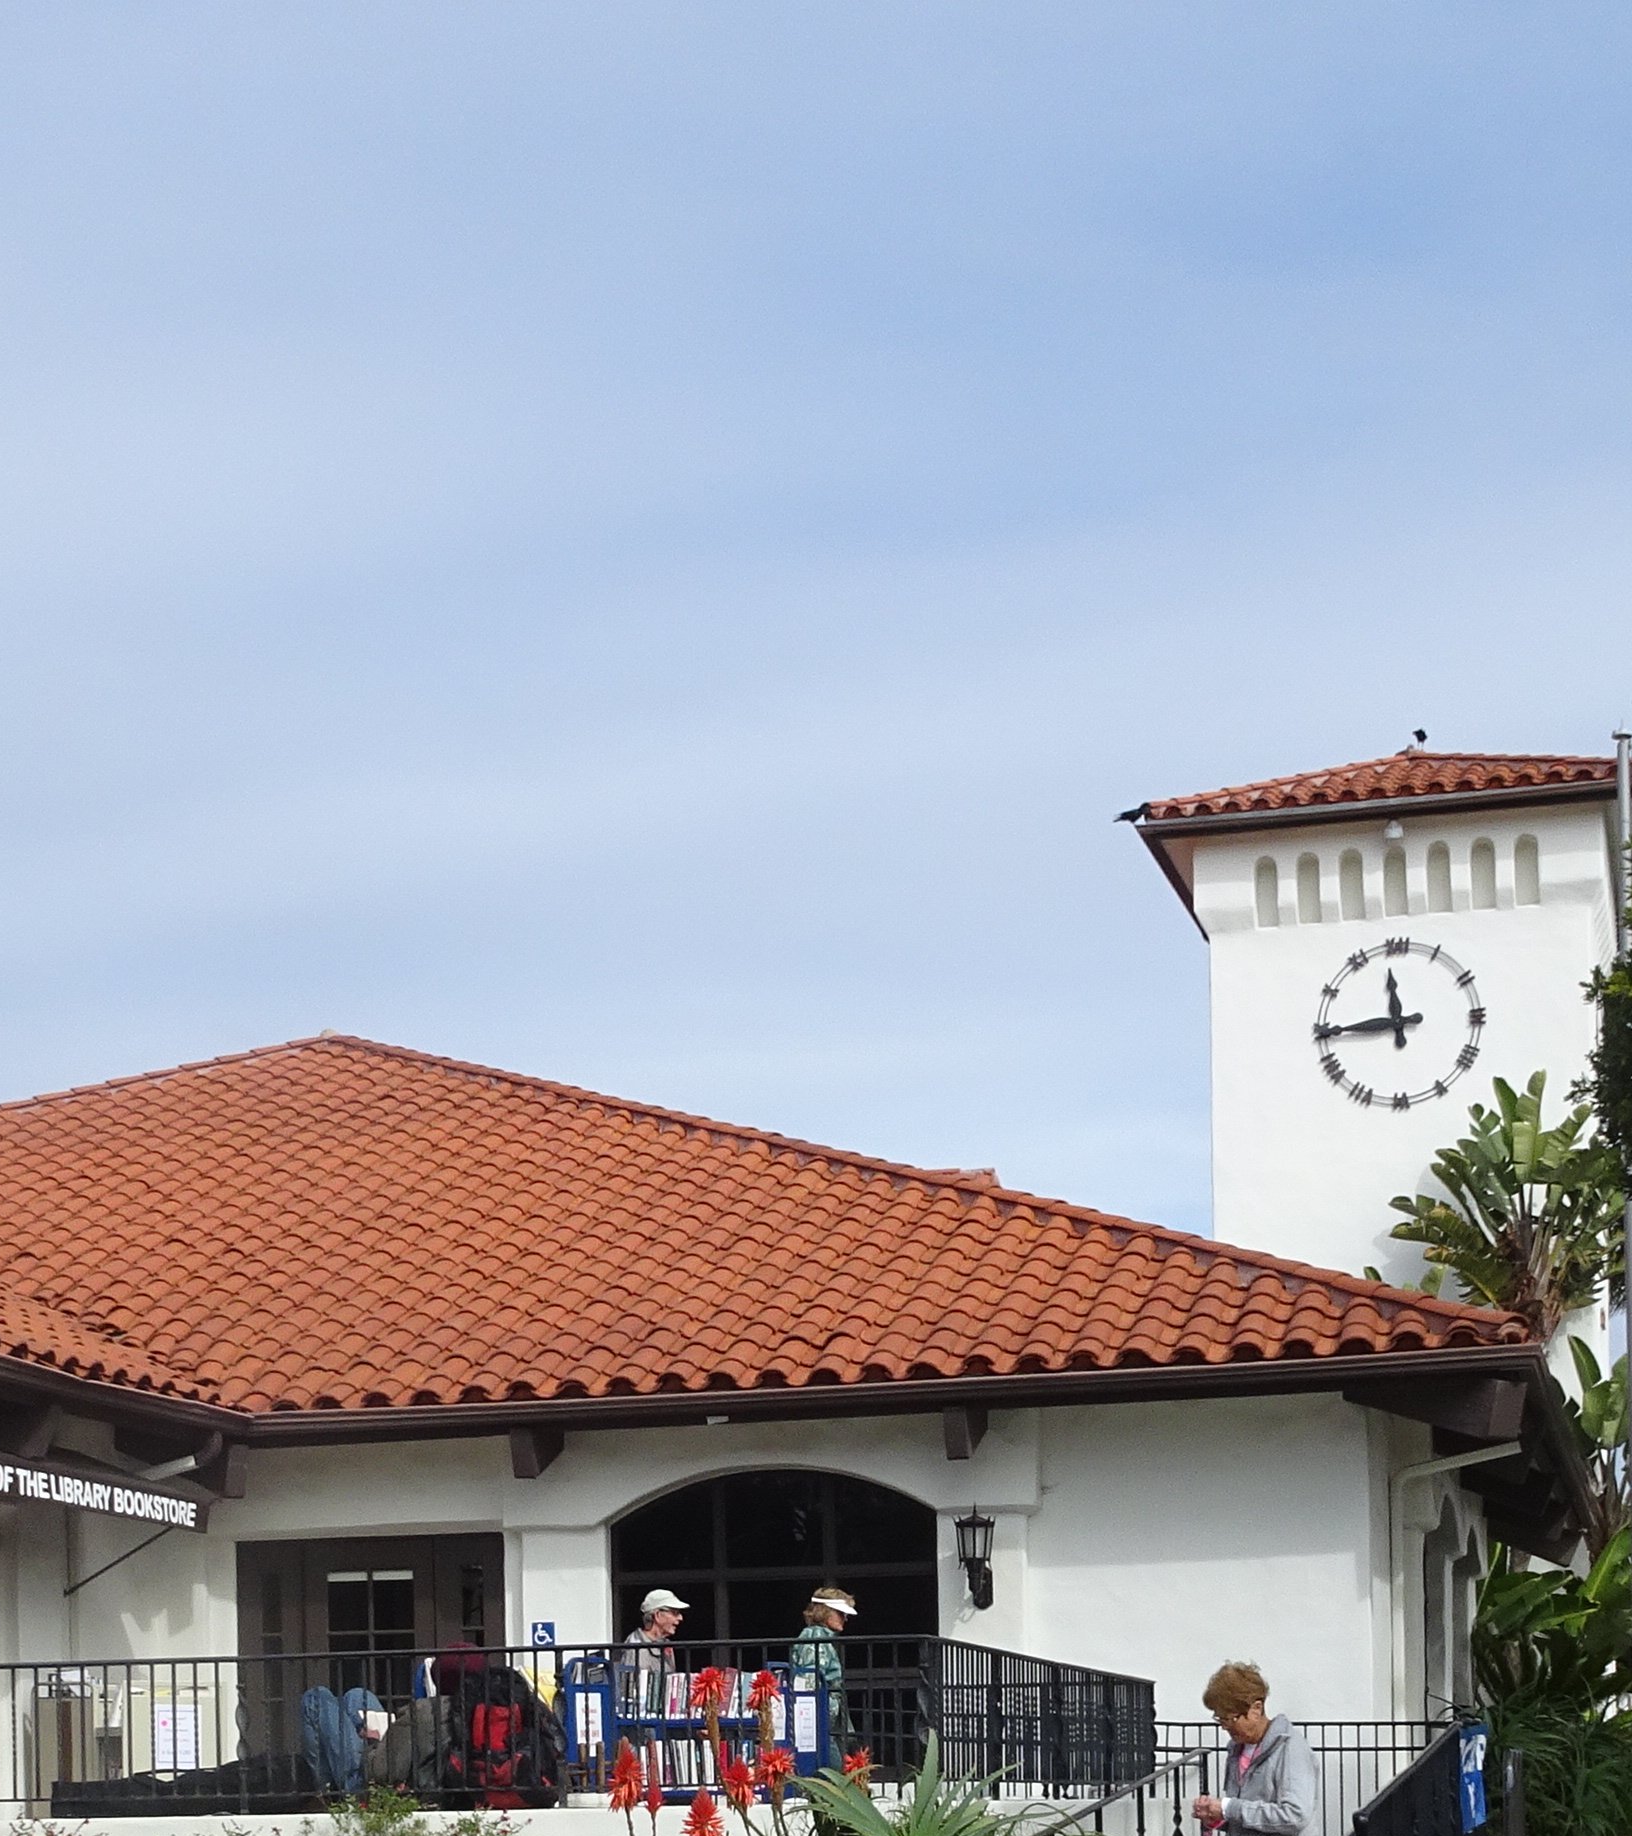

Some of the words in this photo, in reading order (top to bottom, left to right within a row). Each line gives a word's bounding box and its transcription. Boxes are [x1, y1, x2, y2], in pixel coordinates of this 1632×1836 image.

[16, 1468, 50, 1500] THE
[50, 1473, 112, 1512] LIBRARY
[113, 1486, 198, 1528] BOOKSTORE
